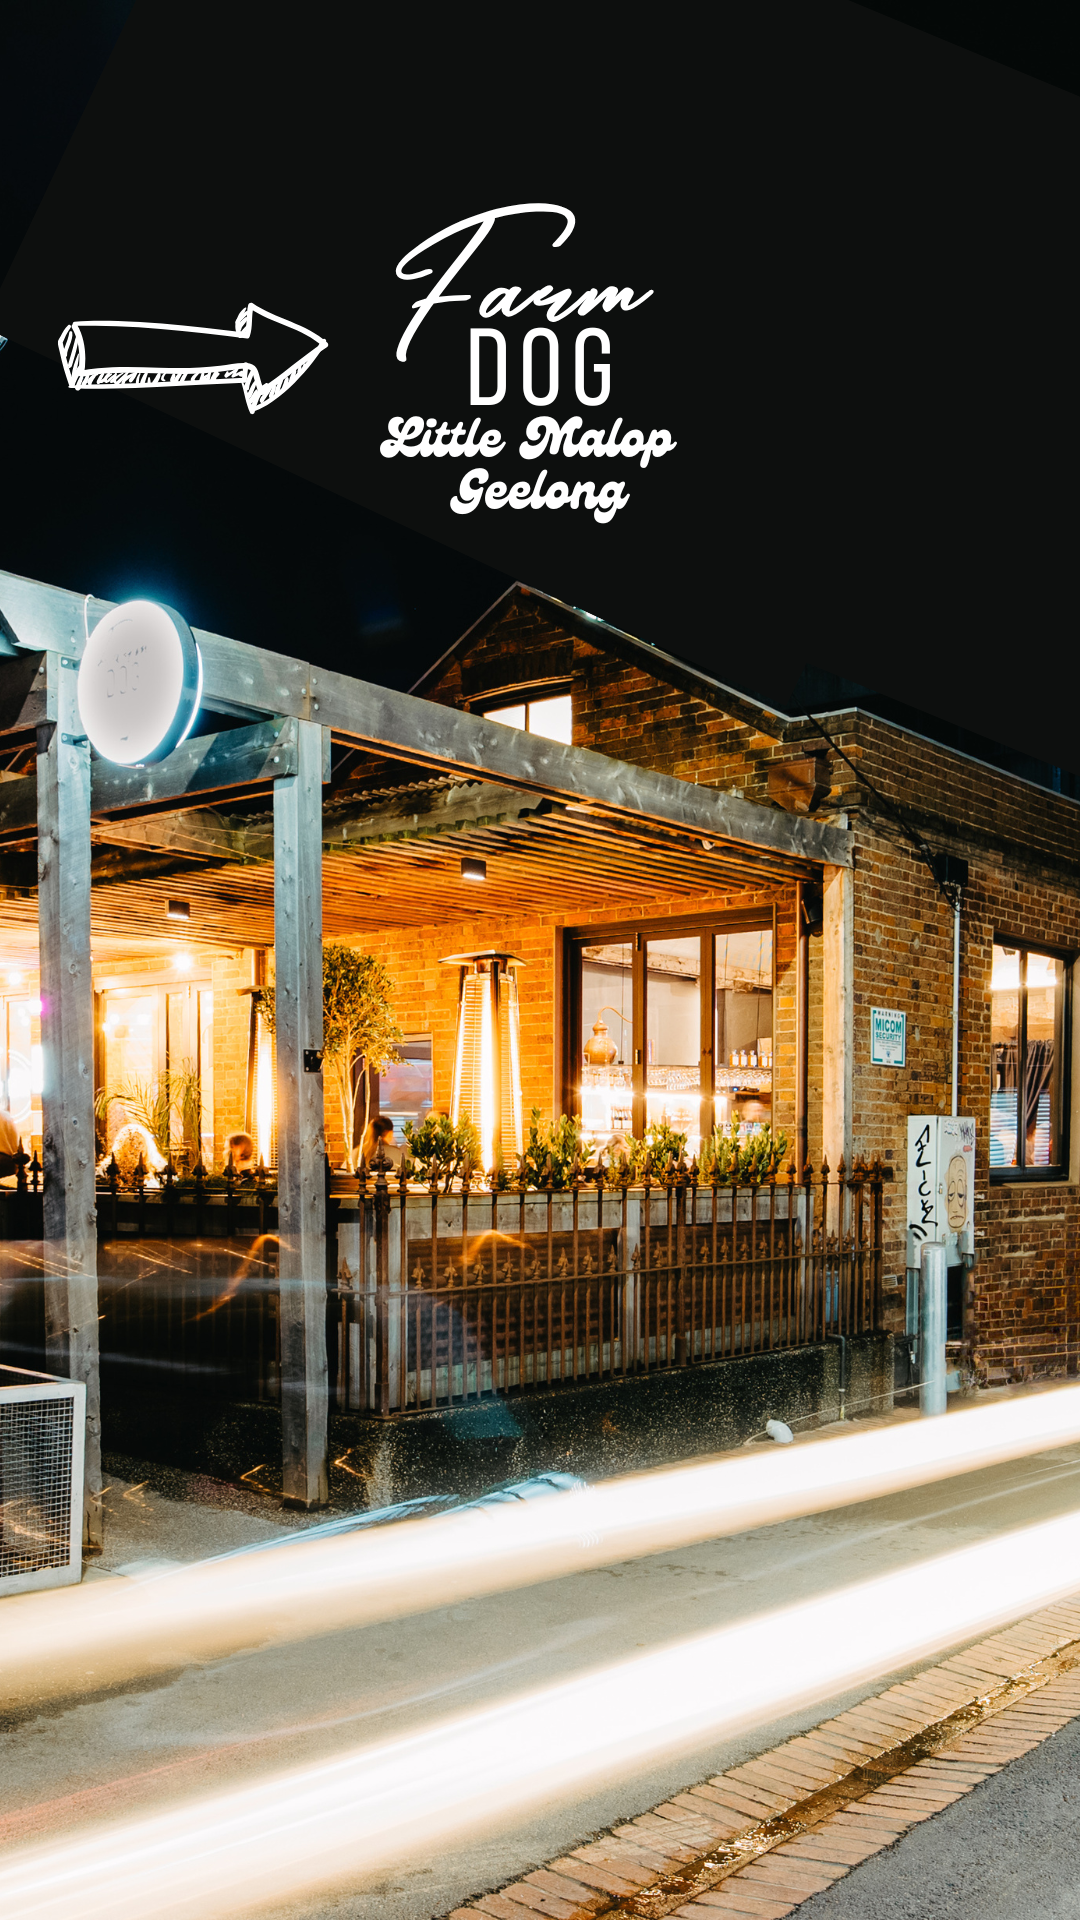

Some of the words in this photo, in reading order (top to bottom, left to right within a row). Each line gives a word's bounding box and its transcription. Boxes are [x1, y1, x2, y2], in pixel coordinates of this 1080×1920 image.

[877, 1010, 901, 1019] WARNING
[875, 1018, 902, 1034] MICOM
[875, 1031, 902, 1041] SECURITY
